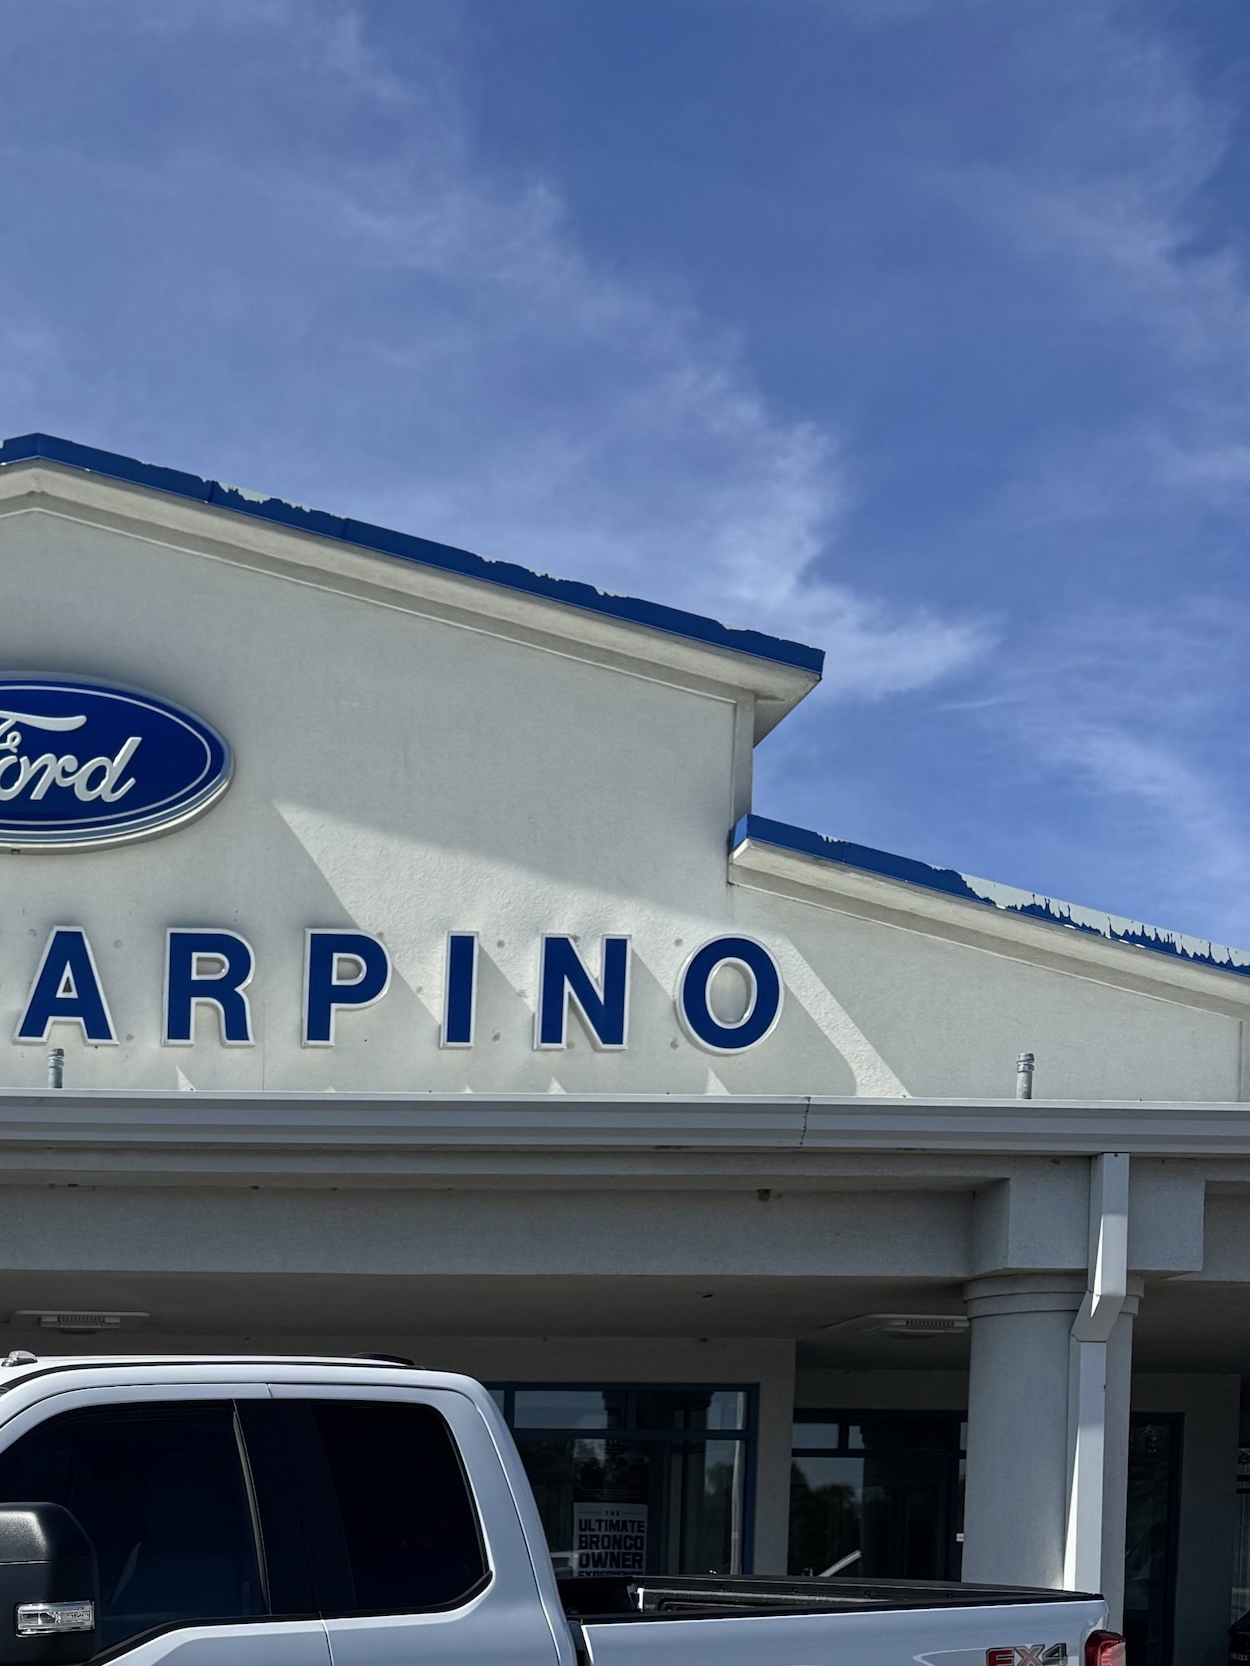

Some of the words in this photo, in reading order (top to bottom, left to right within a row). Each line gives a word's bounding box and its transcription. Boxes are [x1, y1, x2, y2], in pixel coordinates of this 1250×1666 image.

[578, 1518, 645, 1533] ULTIMATE
[578, 1534, 644, 1550] BRONCO
[578, 1551, 644, 1569] OWNER
